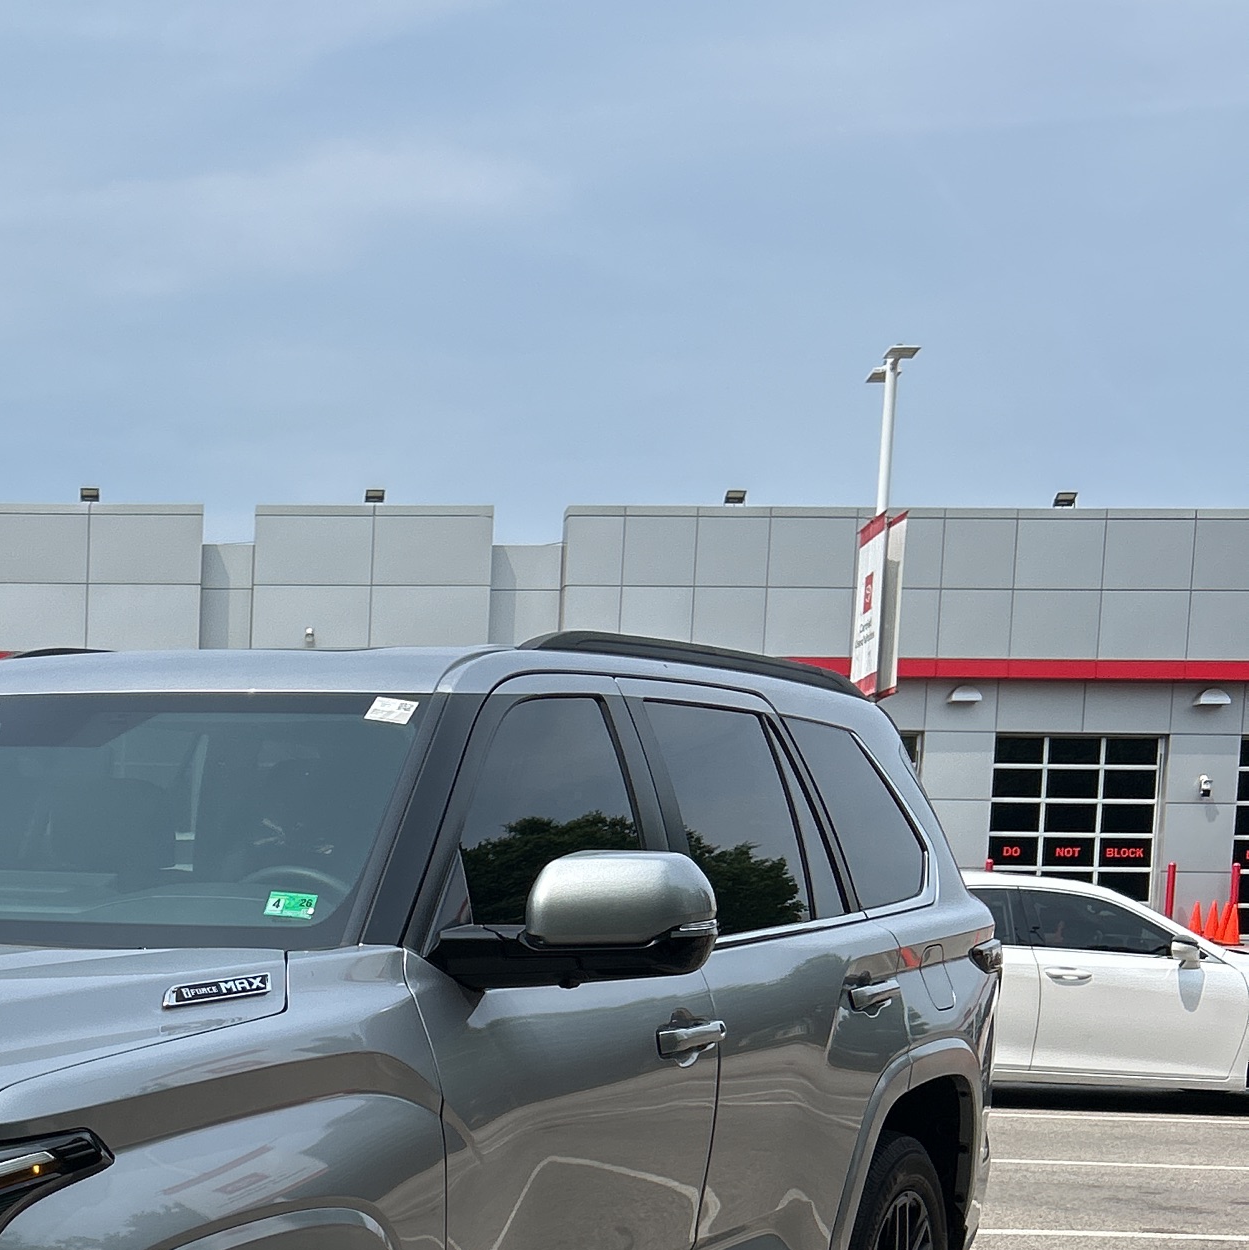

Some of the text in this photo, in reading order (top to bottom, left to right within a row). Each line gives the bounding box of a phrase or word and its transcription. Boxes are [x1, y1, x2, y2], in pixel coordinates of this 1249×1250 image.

[1002, 846, 1144, 858] DO NOT BLOCK
[272, 898, 313, 909] 4 26
[218, 976, 266, 994] MAX
